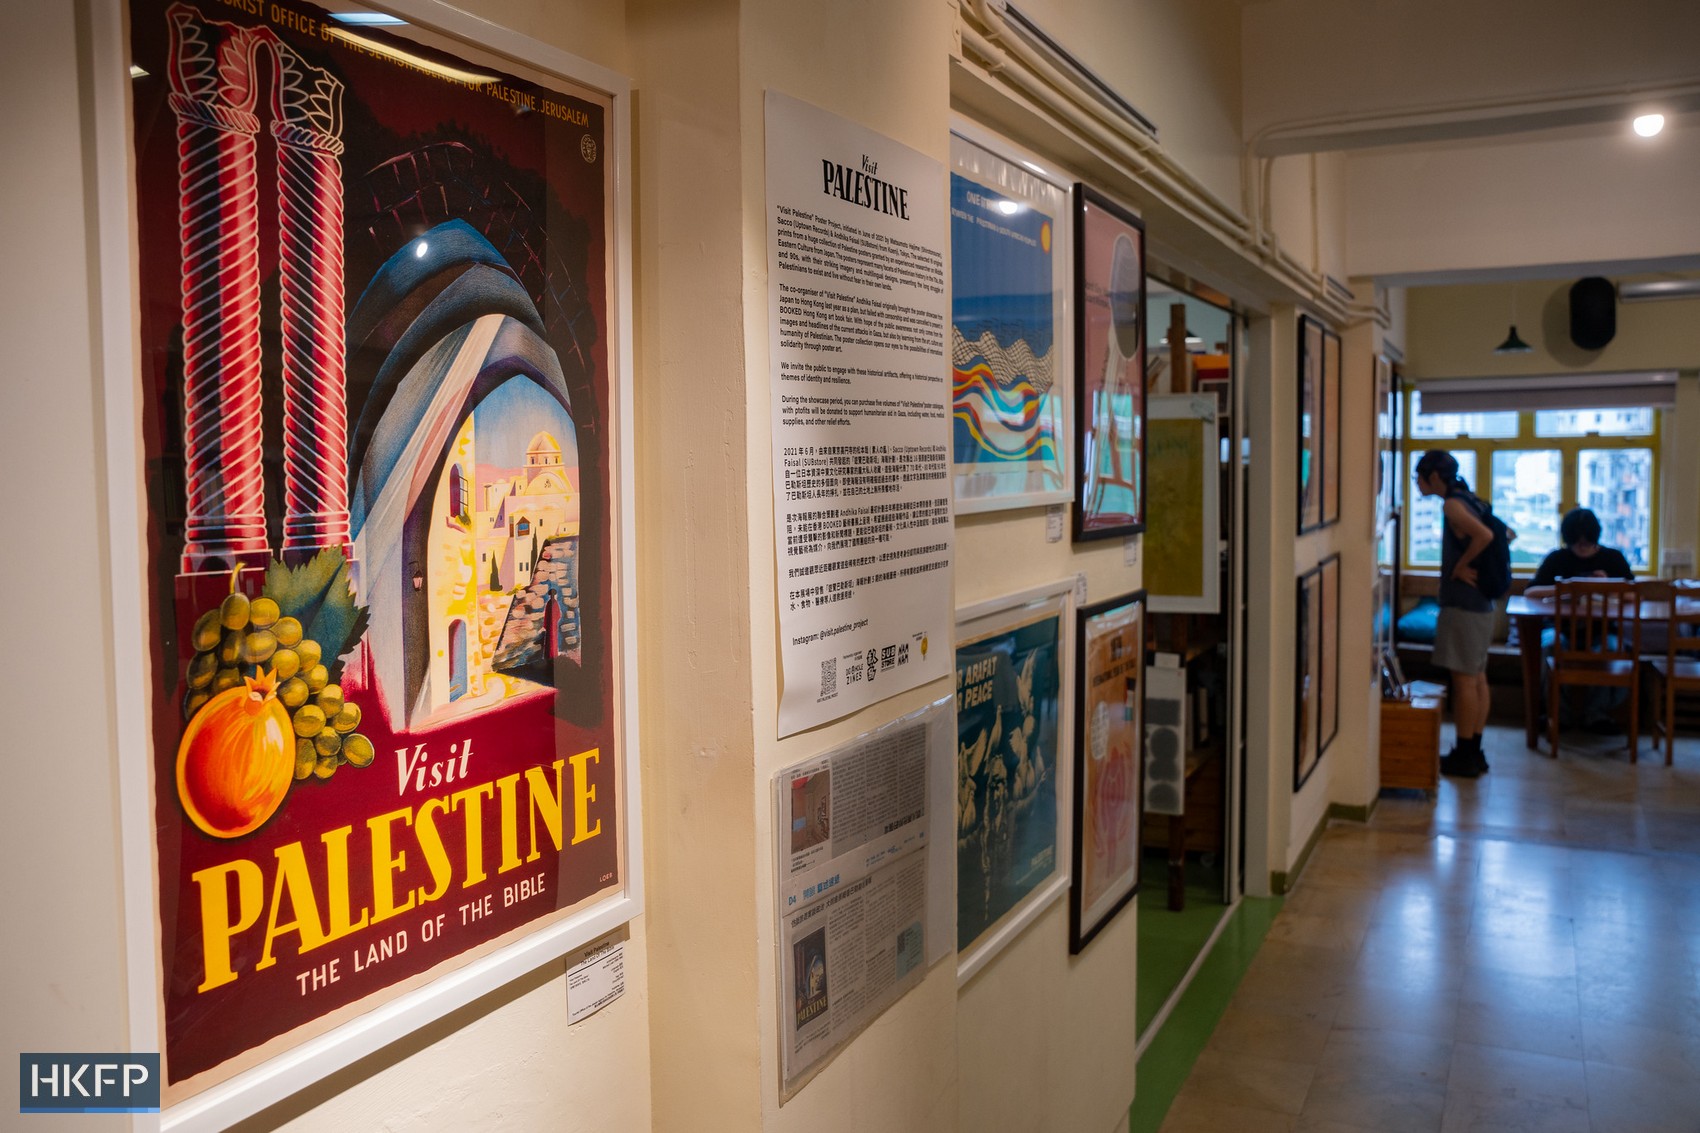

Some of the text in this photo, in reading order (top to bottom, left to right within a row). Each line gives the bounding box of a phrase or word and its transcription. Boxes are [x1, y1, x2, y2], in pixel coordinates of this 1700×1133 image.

[271, 4, 316, 37] OFFICE
[540, 98, 589, 128] JERUSALEM
[862, 154, 878, 175] Visit
[822, 158, 910, 220] PALESTINE
[777, 217, 792, 226] Sacco
[794, 220, 812, 230] (Uptown
[815, 215, 827, 224] Poster
[778, 228, 792, 237] prints
[793, 231, 803, 239] from
[808, 234, 818, 244] huge
[819, 238, 836, 248] collection
[842, 244, 858, 254] Palestine
[778, 239, 796, 248] Eastern
[798, 243, 813, 252] Culture
[814, 246, 823, 254] from
[824, 249, 835, 258] Japan.
[779, 261, 807, 273] Palestinians
[790, 252, 800, 261] 90s,
[824, 260, 838, 270] striking
[790, 287, 818, 296] co-organiser
[780, 295, 794, 304] Japan
[801, 298, 812, 308] Hong
[813, 300, 824, 310] Kong
[780, 306, 802, 315] BOOKED
[803, 309, 815, 319] Hong
[816, 311, 827, 320] Kong
[780, 317, 798, 327] images
[809, 320, 828, 330] headlines
[780, 328, 803, 339] humanity
[810, 332, 833, 340] Palestinian.
[781, 340, 803, 350] solidarity
[804, 342, 821, 351] through
[791, 362, 804, 370] invite
[806, 374, 822, 384] identity
[782, 395, 799, 404] During
[783, 418, 804, 426] supplies,
[784, 458, 828, 467] Faisal (SUBstore)
[823, 520, 842, 529] BOOKED
[792, 618, 868, 646] Instagram: @visit.palestine_project
[881, 658, 895, 668] STORE
[846, 672, 862, 685] ZINES
[964, 680, 993, 710] PEACE
[394, 738, 475, 796] Visit
[192, 746, 602, 994] PALESTINE
[788, 895, 797, 905] D4
[296, 872, 546, 996] THE LAND OF THE BIBLE
